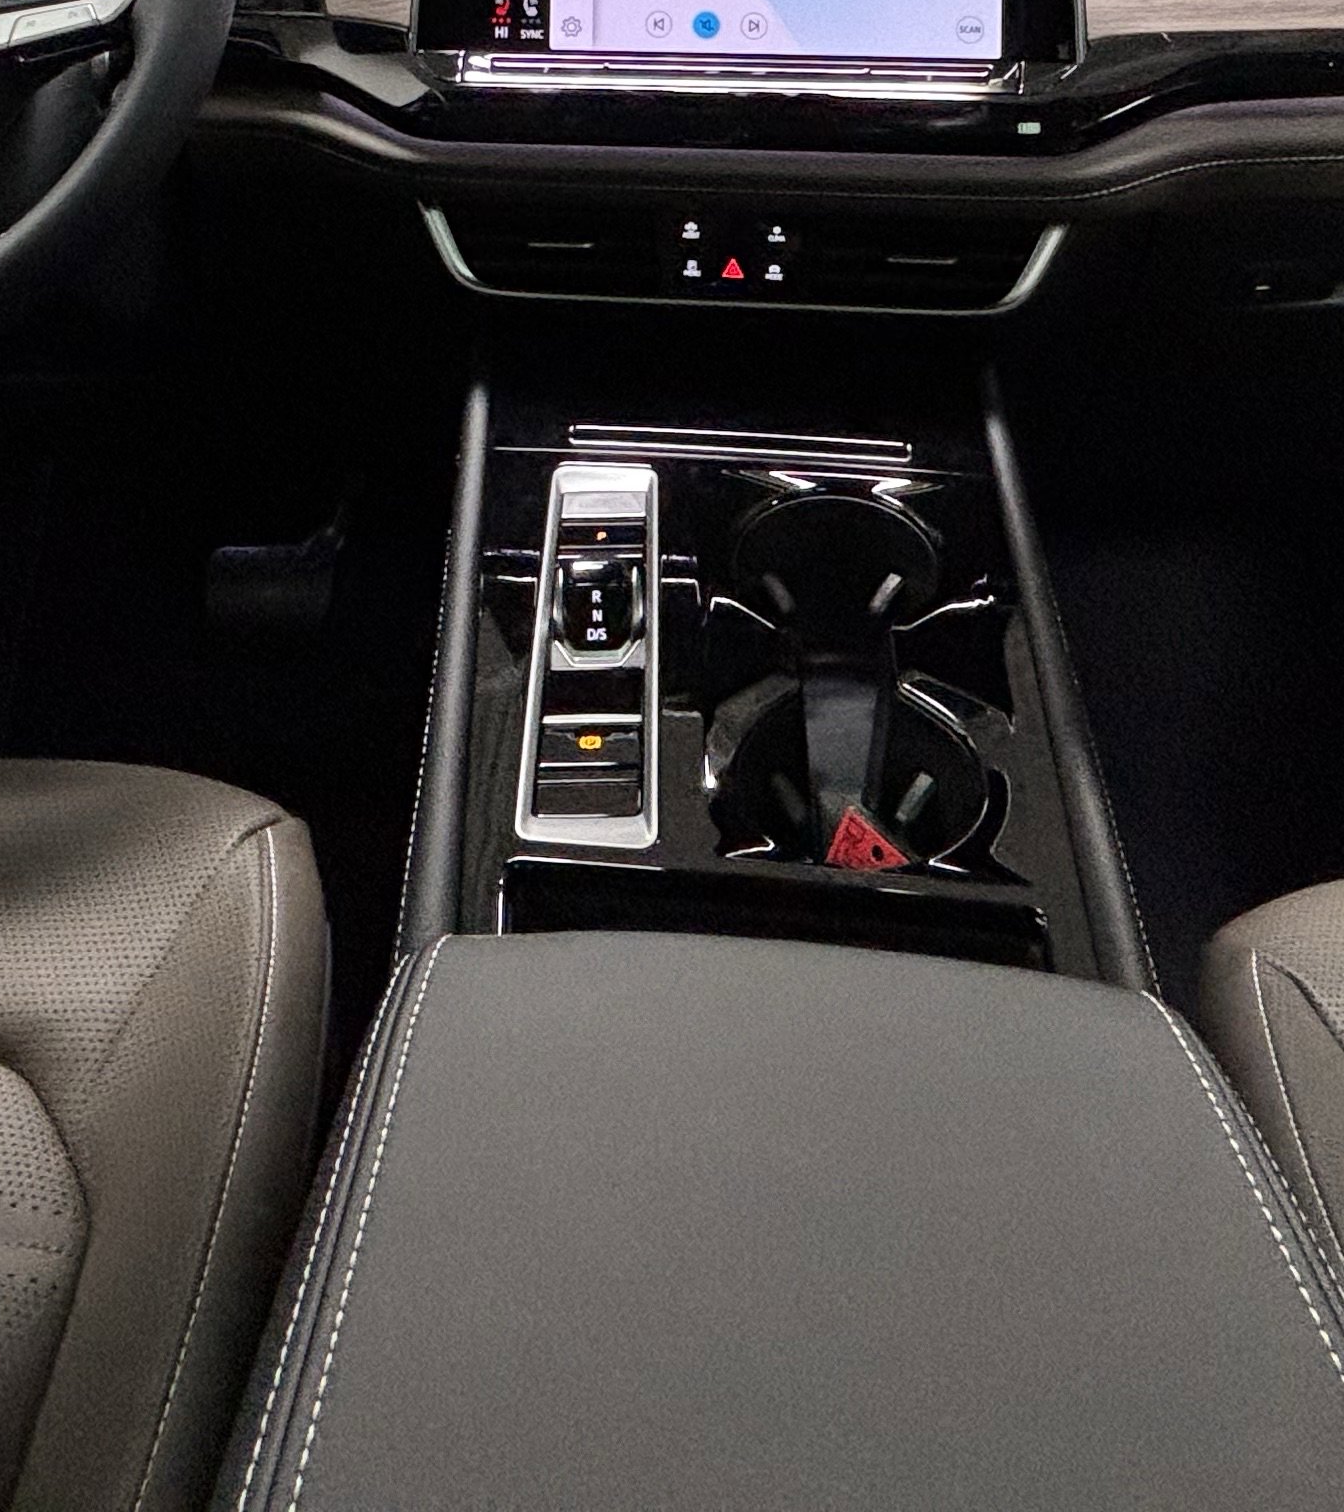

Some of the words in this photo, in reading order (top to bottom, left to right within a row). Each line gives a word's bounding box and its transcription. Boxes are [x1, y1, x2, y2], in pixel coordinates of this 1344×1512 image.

[494, 26, 509, 39] HI
[520, 29, 545, 40] SYNC
[959, 25, 981, 34] SCAN
[591, 589, 603, 604] R
[592, 609, 603, 623] N
[586, 627, 607, 641] D/S
